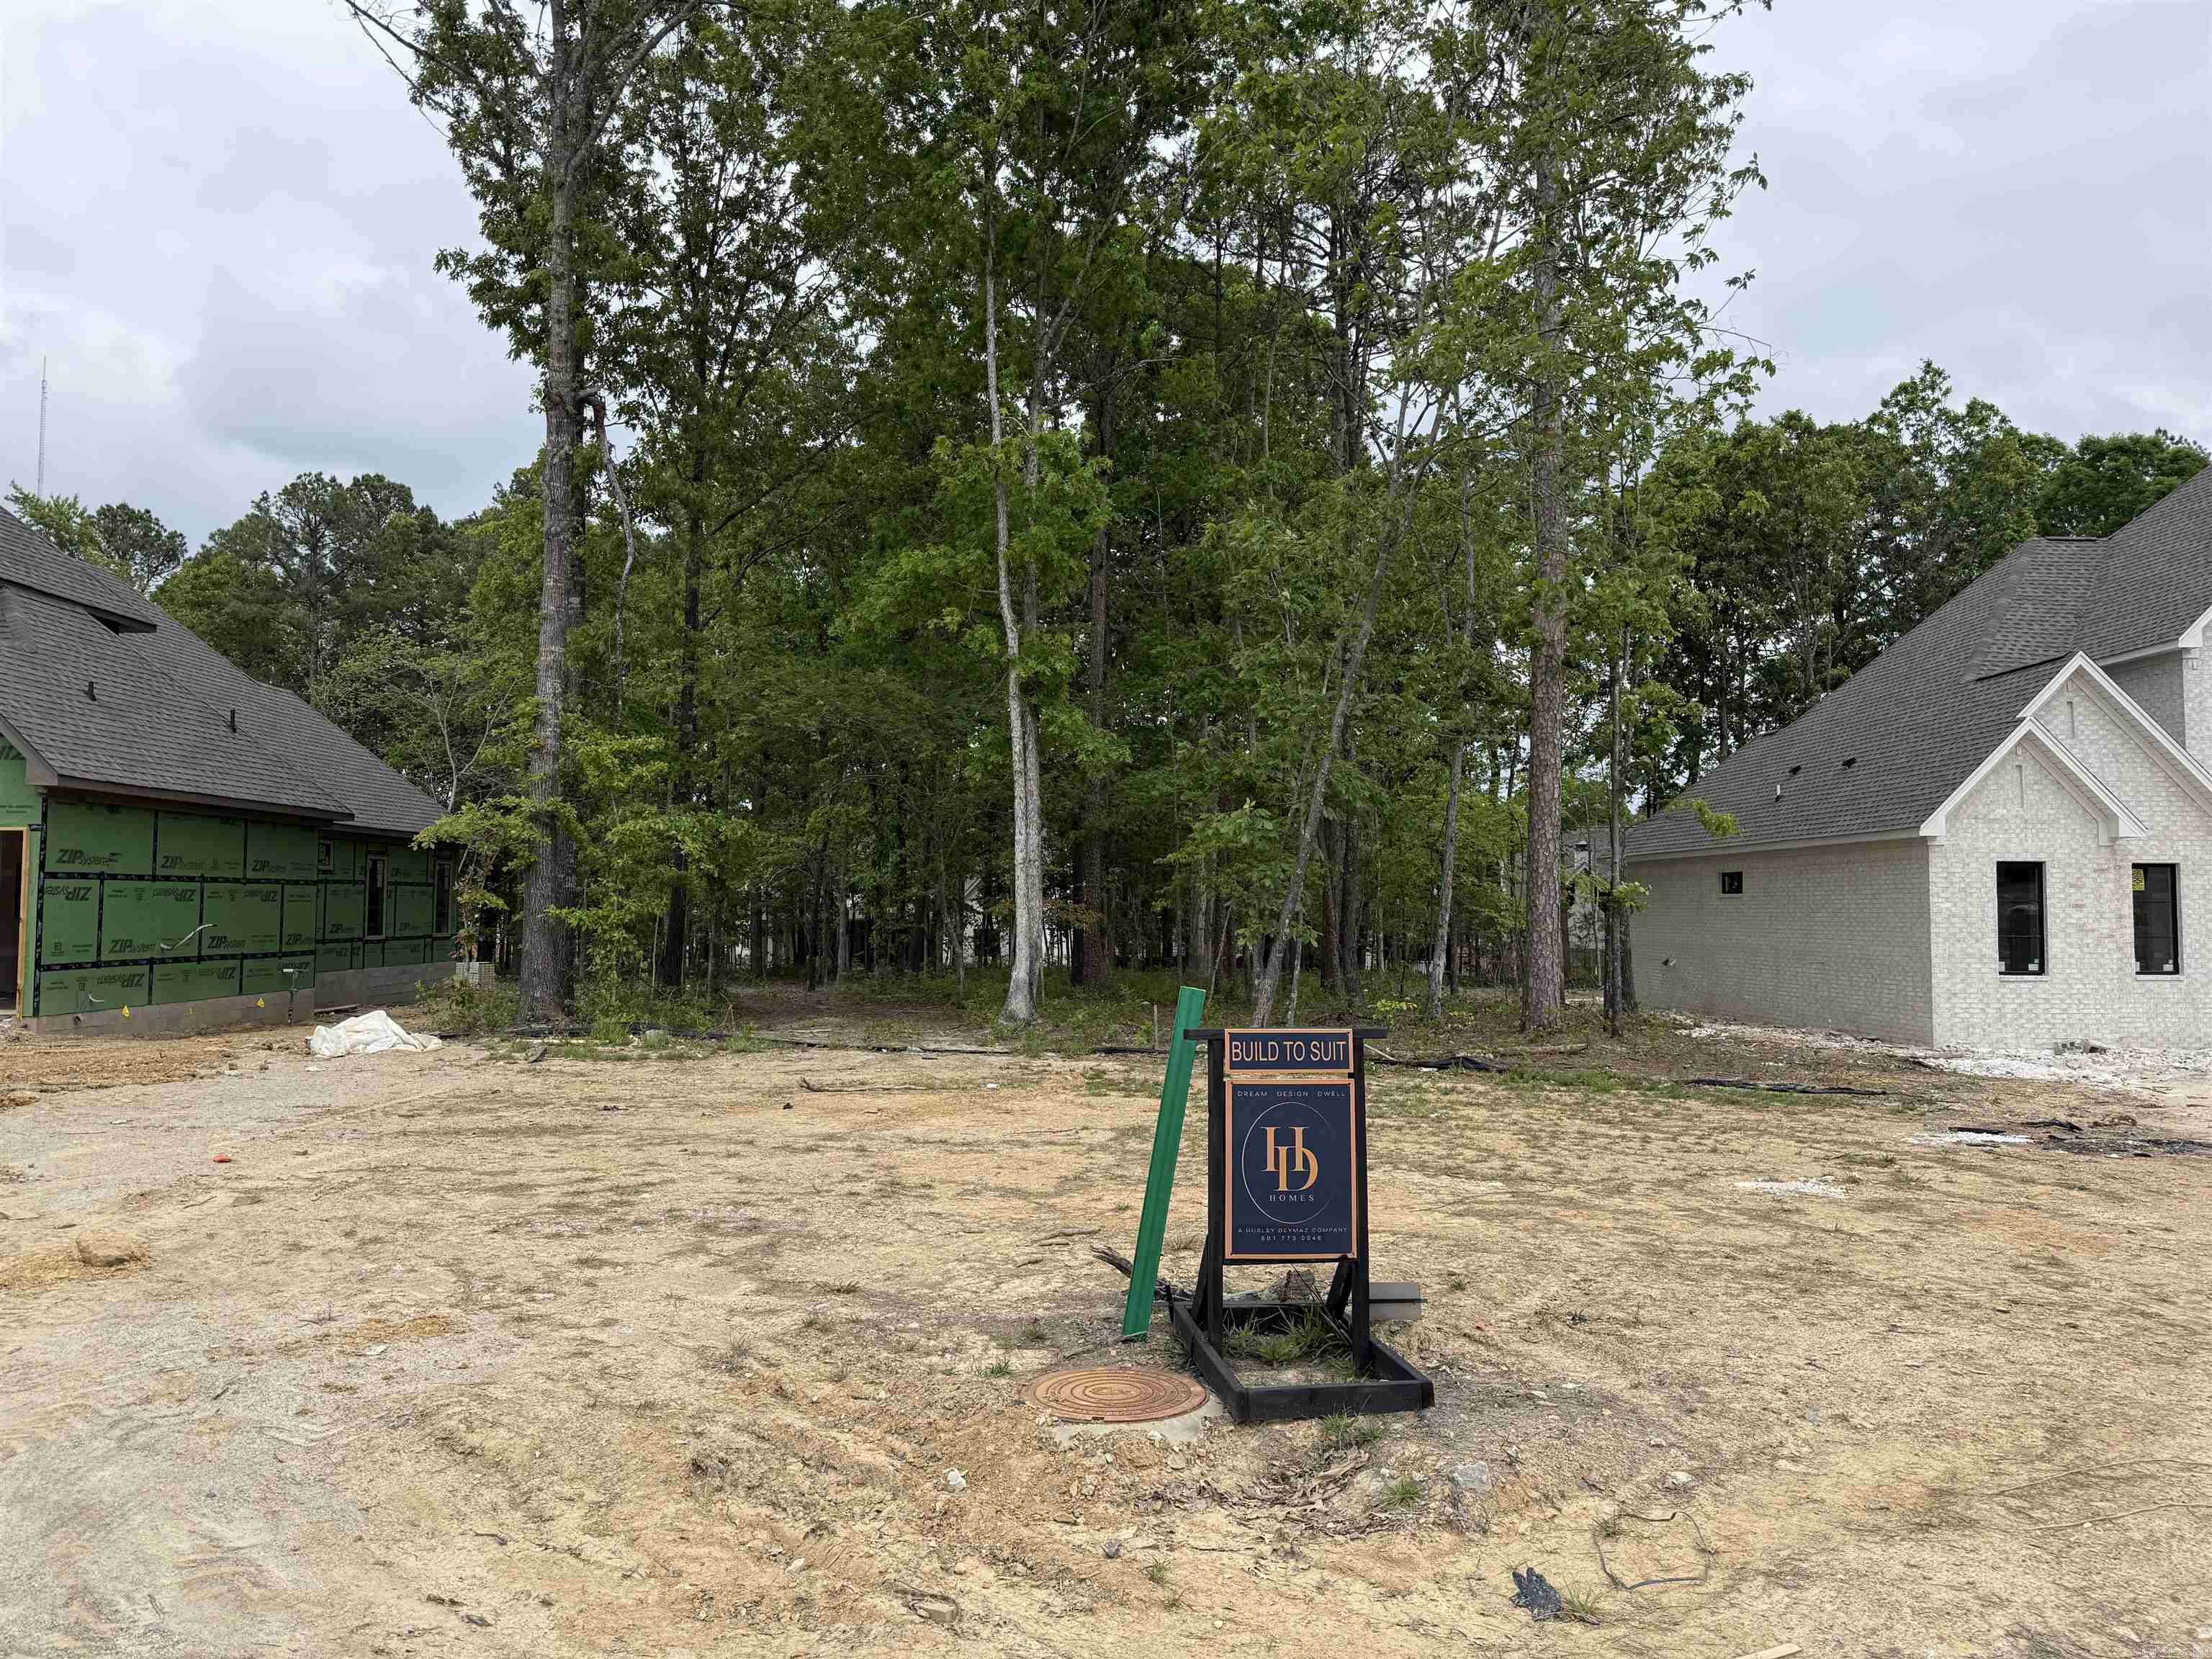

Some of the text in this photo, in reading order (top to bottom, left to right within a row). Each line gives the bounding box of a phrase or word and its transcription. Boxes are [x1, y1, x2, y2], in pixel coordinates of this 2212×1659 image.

[1232, 1041, 1346, 1061] BUILD TO SUIT
